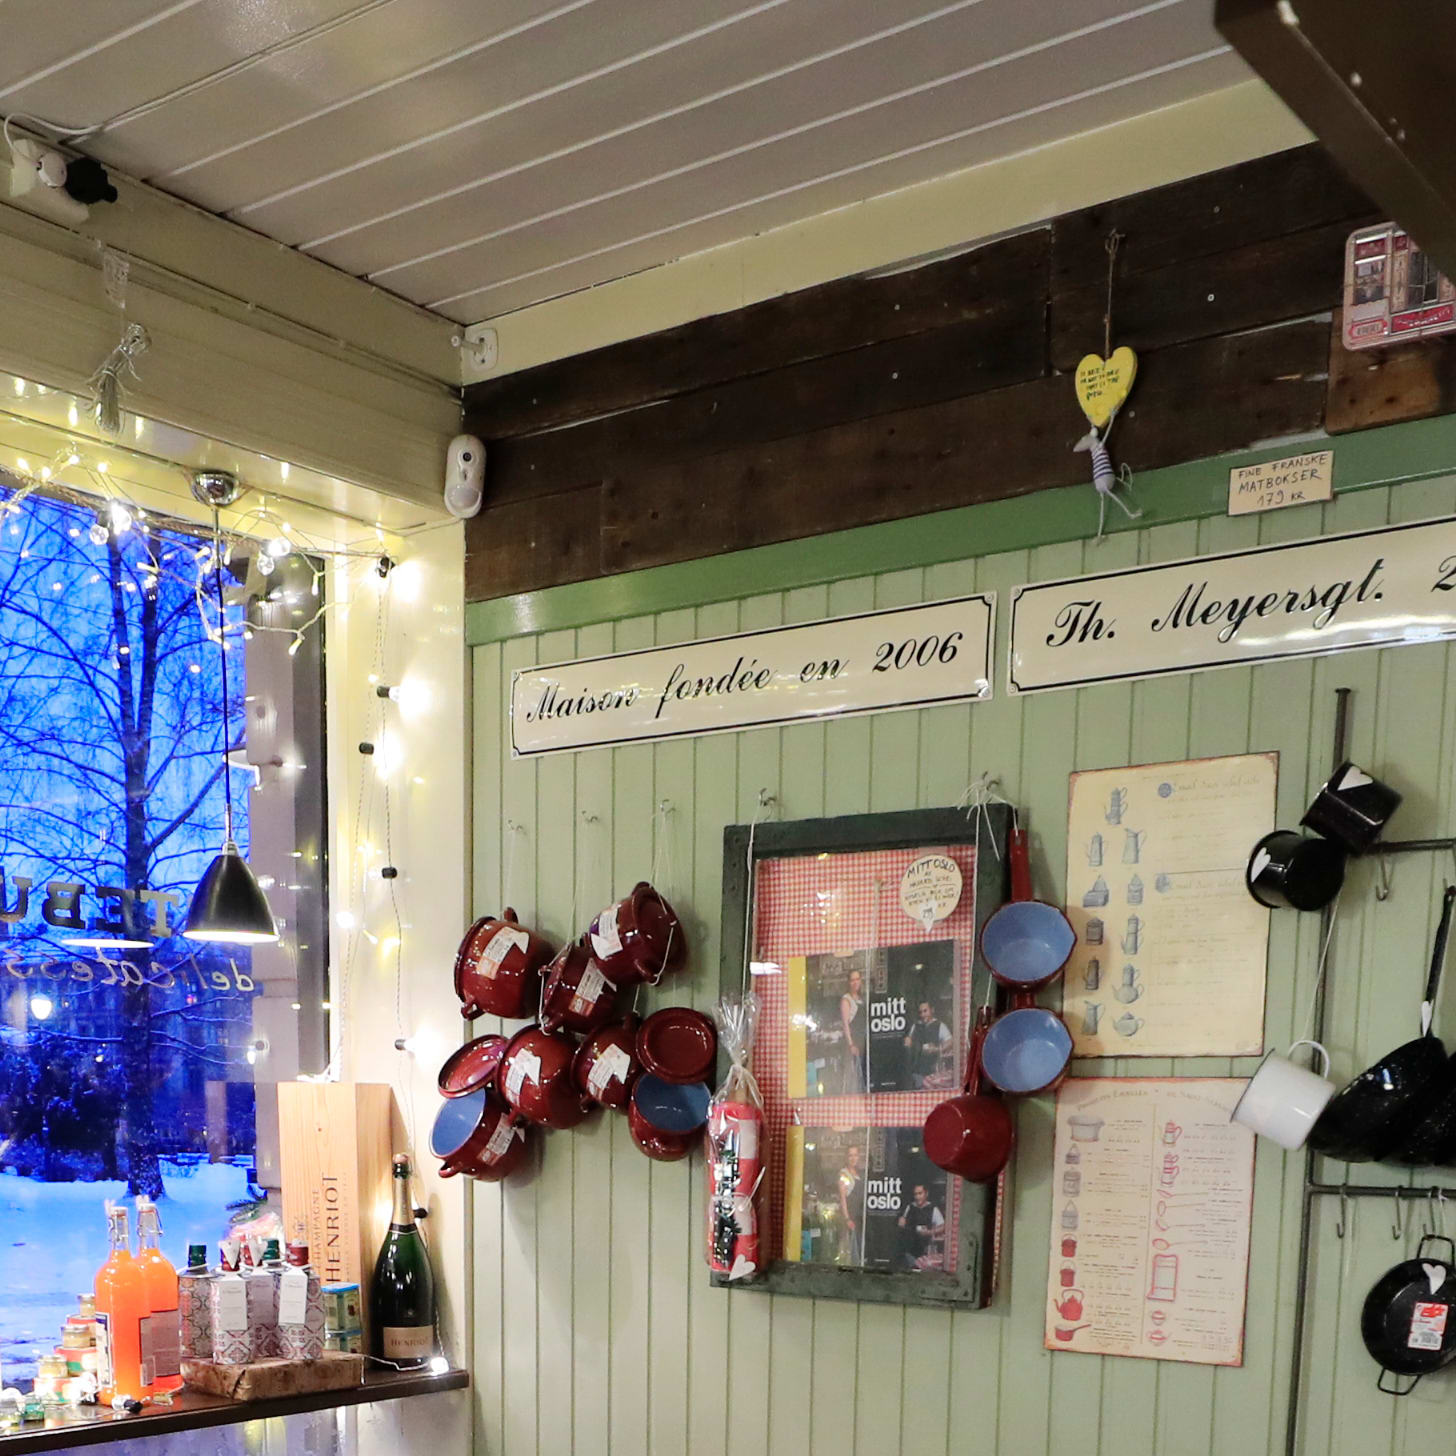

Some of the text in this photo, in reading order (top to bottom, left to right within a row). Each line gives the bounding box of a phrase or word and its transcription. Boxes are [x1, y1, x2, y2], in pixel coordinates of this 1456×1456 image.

[1237, 453, 1328, 481] FINE FRANSKE
[1238, 469, 1322, 494] MATBOKSER
[1257, 490, 1305, 507] 179 KR
[1045, 599, 1117, 649] Th.
[1150, 558, 1384, 644] Meyersgt.
[526, 631, 965, 724] Maison fondée en 2006
[907, 859, 933, 878] MITT
[870, 997, 907, 1015] mitt
[870, 1014, 906, 1033] oslo
[867, 1177, 902, 1194] mitt
[867, 1193, 901, 1210] oslo
[321, 1172, 341, 1282] HENRIOT
